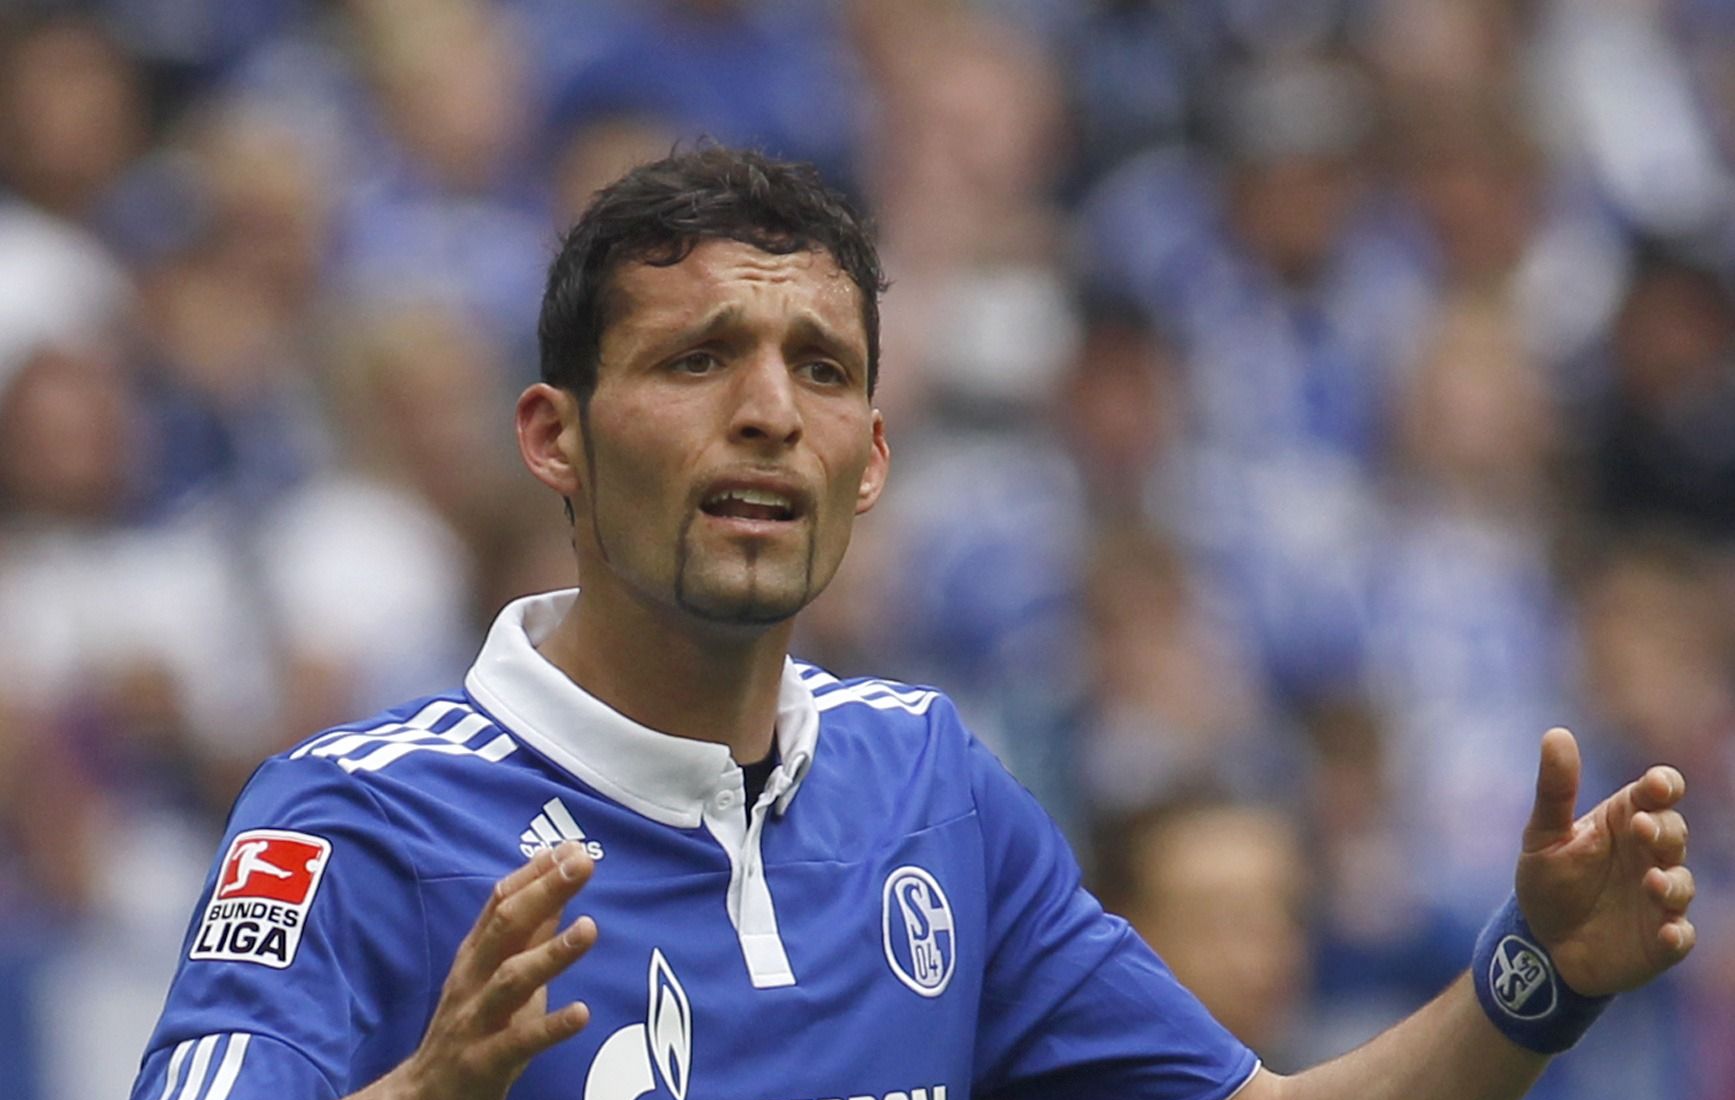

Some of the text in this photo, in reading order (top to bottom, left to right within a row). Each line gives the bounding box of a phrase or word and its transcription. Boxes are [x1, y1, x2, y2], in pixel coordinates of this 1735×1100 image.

[207, 902, 300, 929] BUNDES
[195, 921, 287, 962] LIGA
[915, 942, 939, 980] 04
